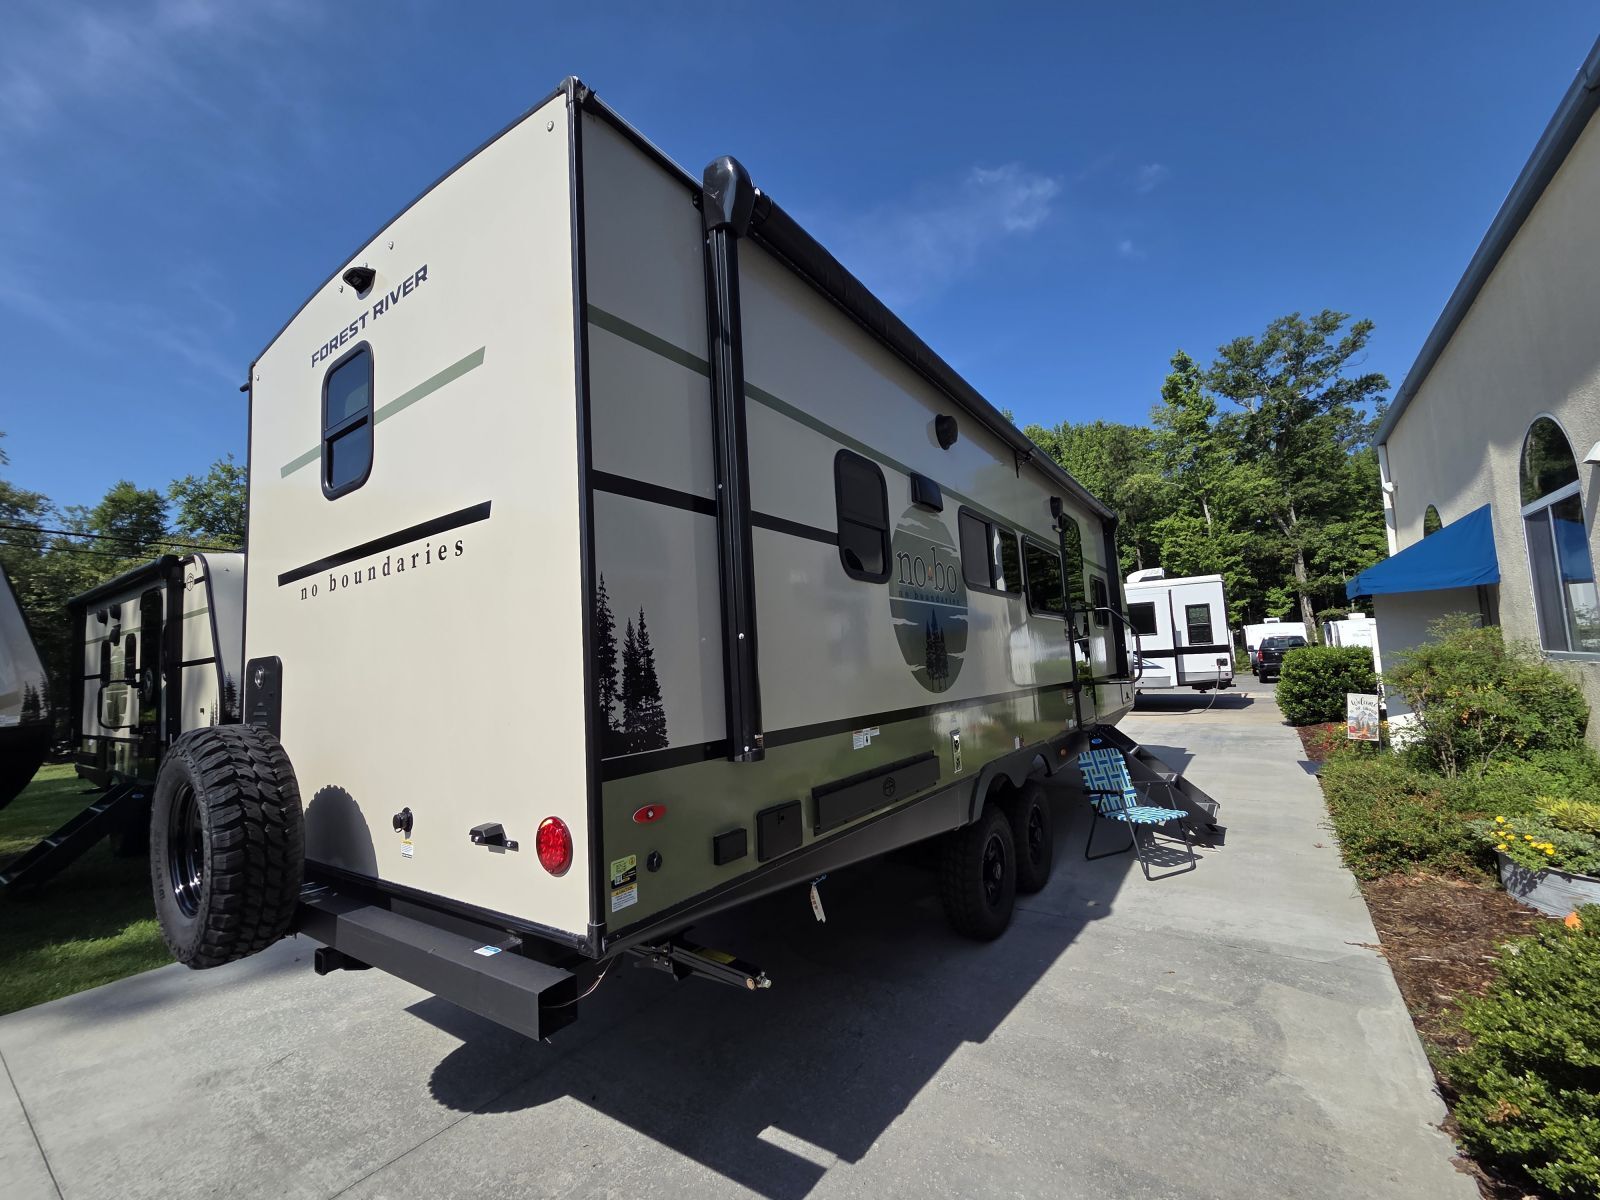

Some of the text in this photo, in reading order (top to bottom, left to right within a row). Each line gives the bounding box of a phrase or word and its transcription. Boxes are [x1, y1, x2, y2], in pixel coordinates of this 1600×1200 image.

[311, 263, 428, 368] FOREST RIVER
[300, 539, 464, 600] no boundaries
